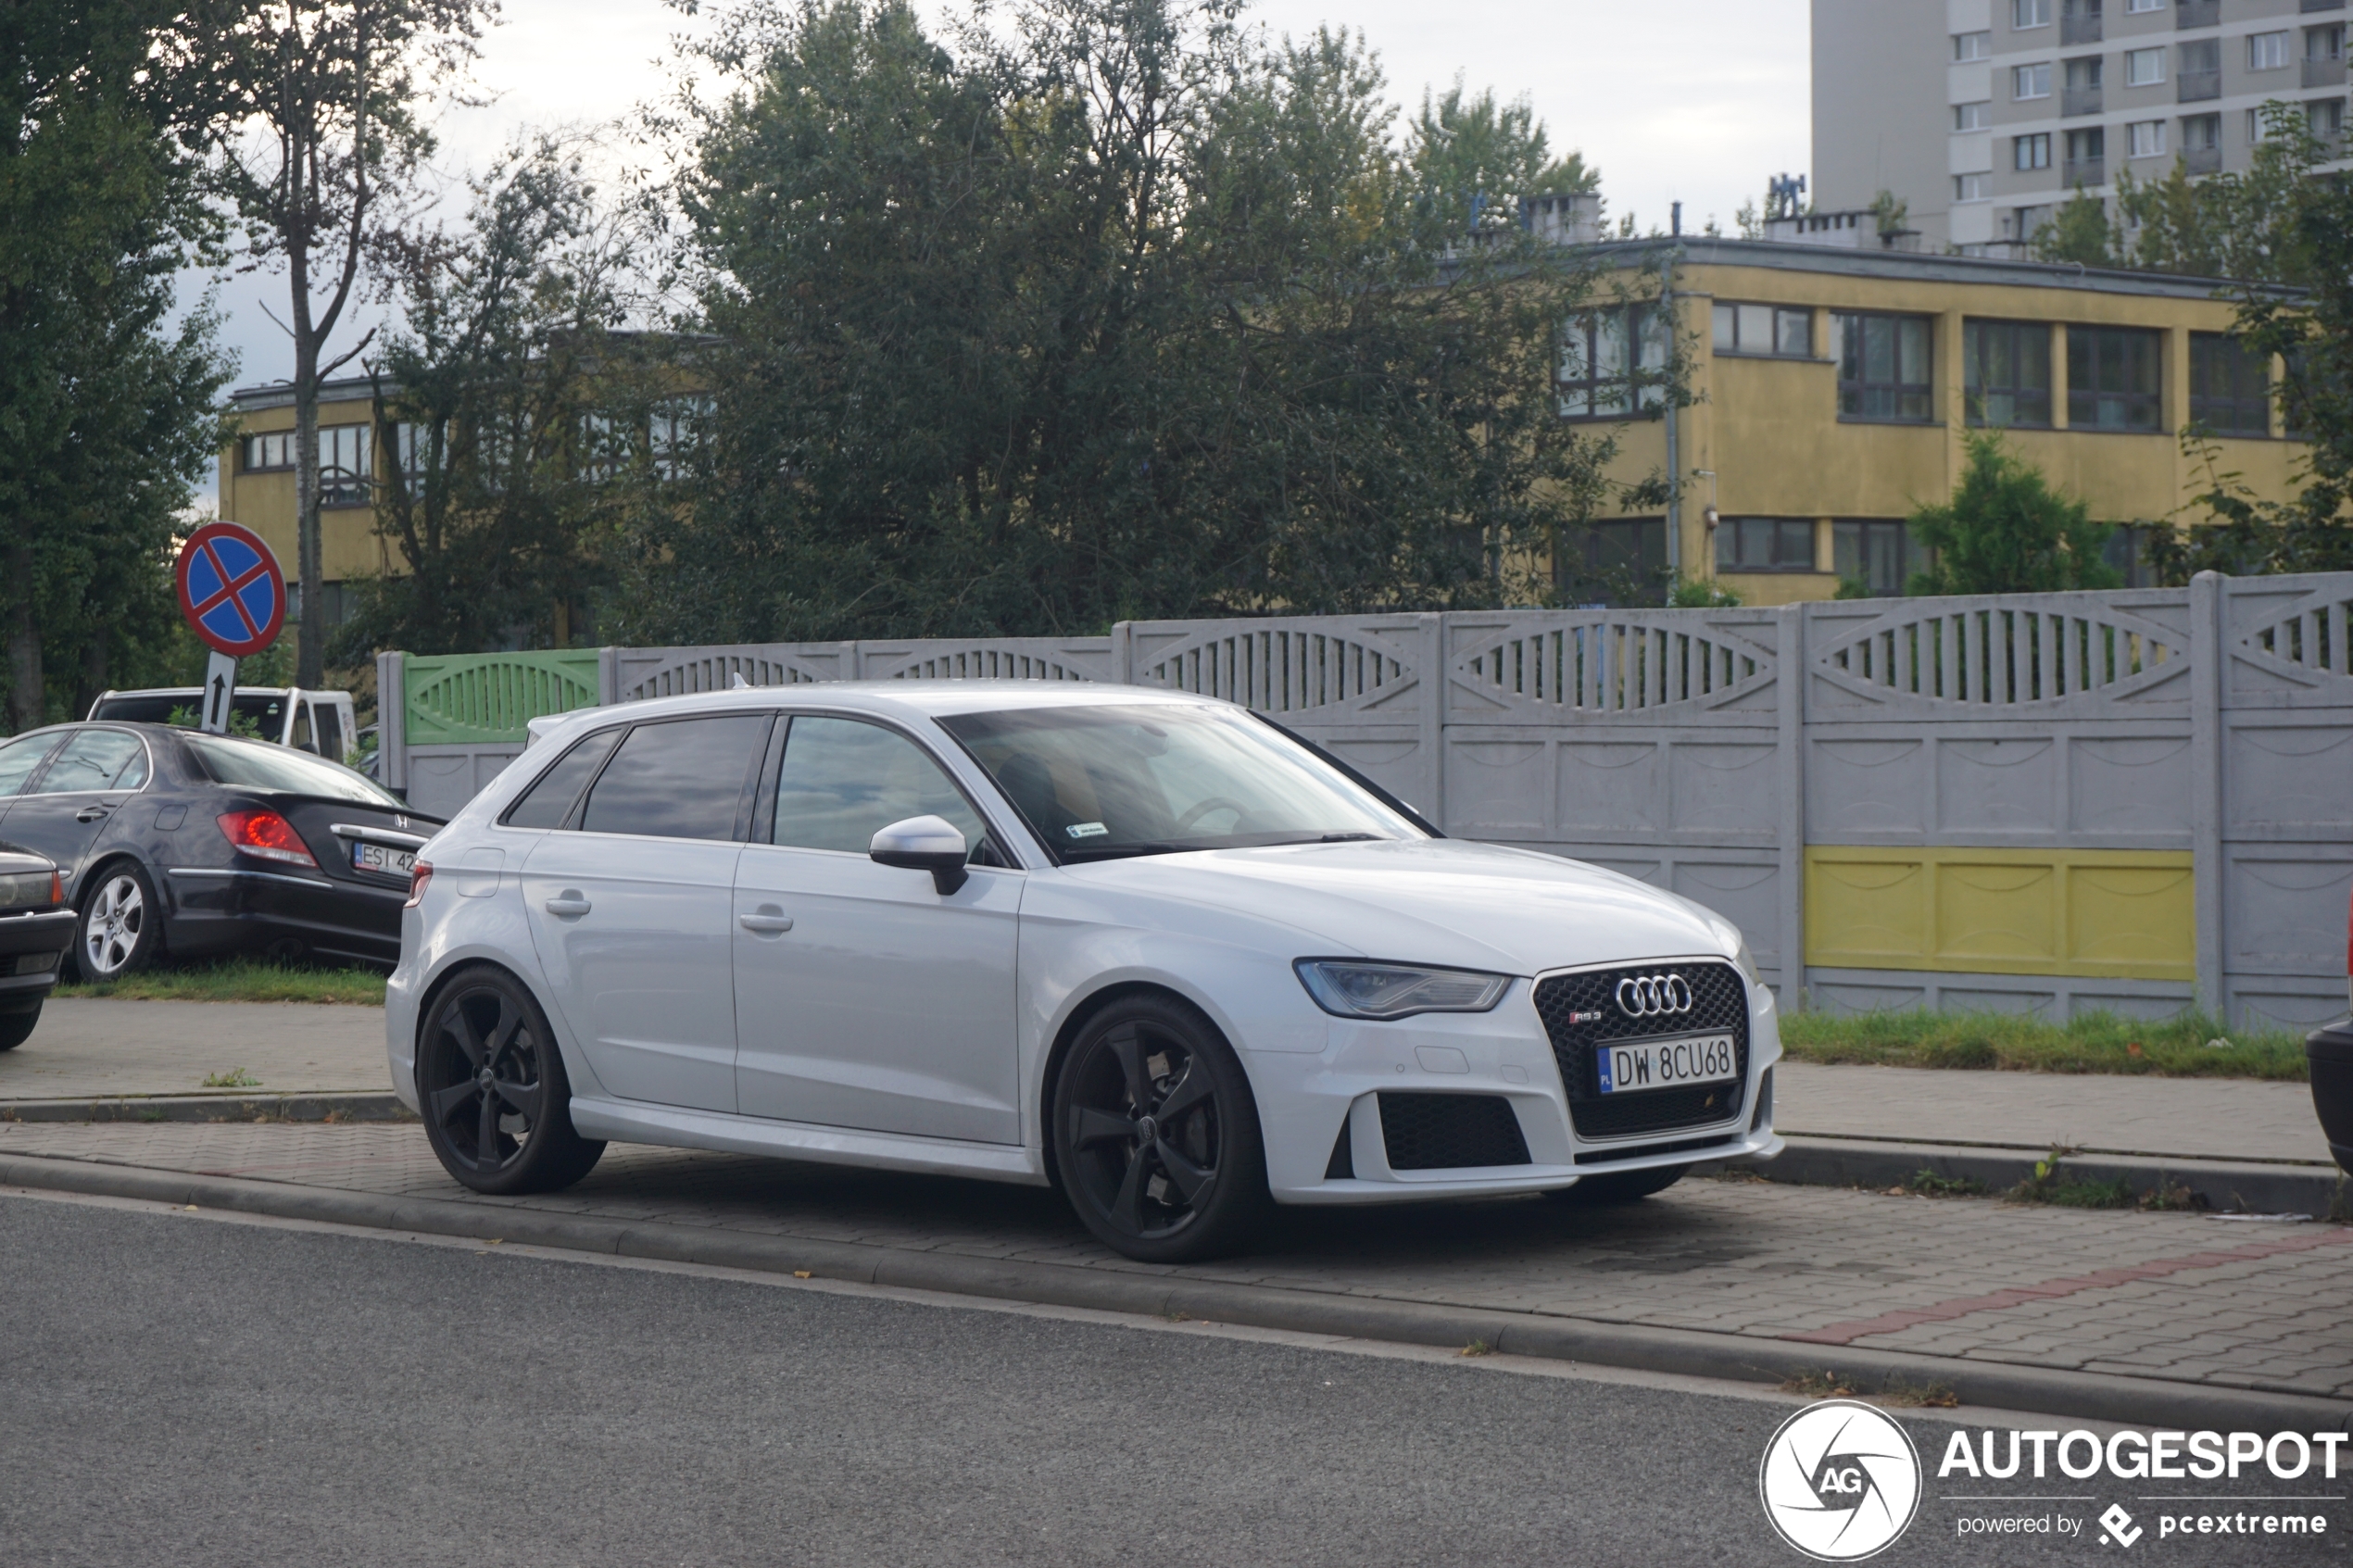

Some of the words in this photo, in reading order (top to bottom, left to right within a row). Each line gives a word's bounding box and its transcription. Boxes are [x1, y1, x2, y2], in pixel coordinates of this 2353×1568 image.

[1616, 1048, 1650, 1085] DW
[1659, 1040, 1730, 1080] 8CU68
[1601, 1074, 1611, 1085] PL
